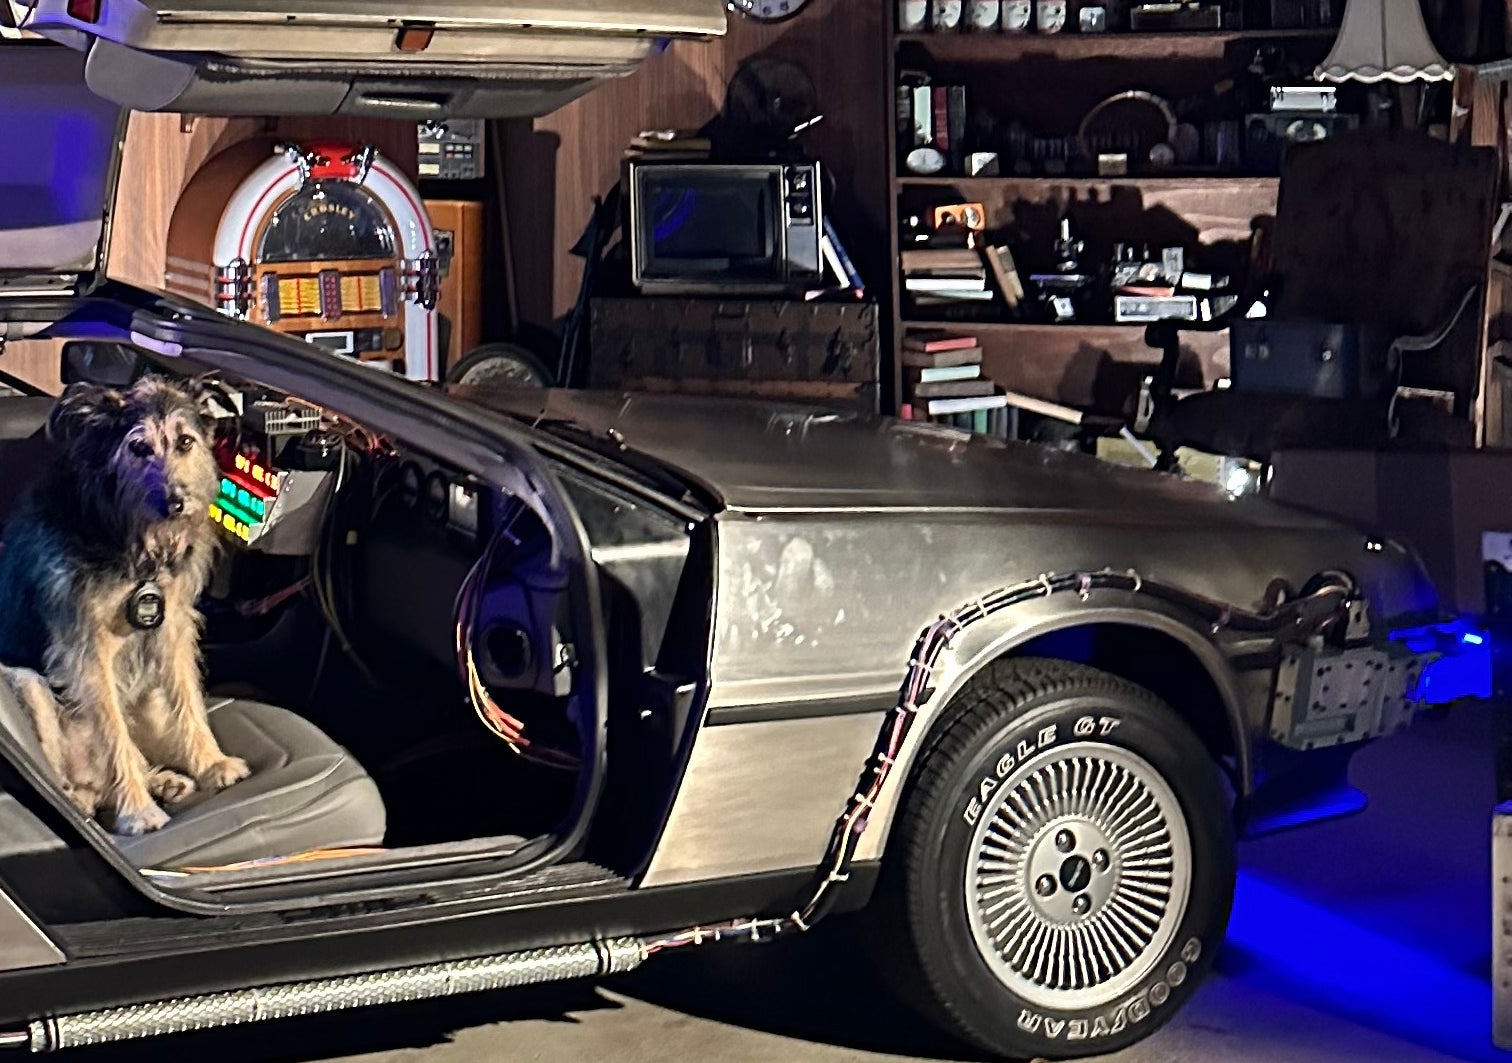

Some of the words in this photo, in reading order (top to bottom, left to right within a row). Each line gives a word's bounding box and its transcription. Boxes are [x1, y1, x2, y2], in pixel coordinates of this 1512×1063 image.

[963, 724, 1057, 826] EAGLE
[1073, 716, 1121, 737] GT
[1017, 937, 1202, 1040] GOODYEAR
